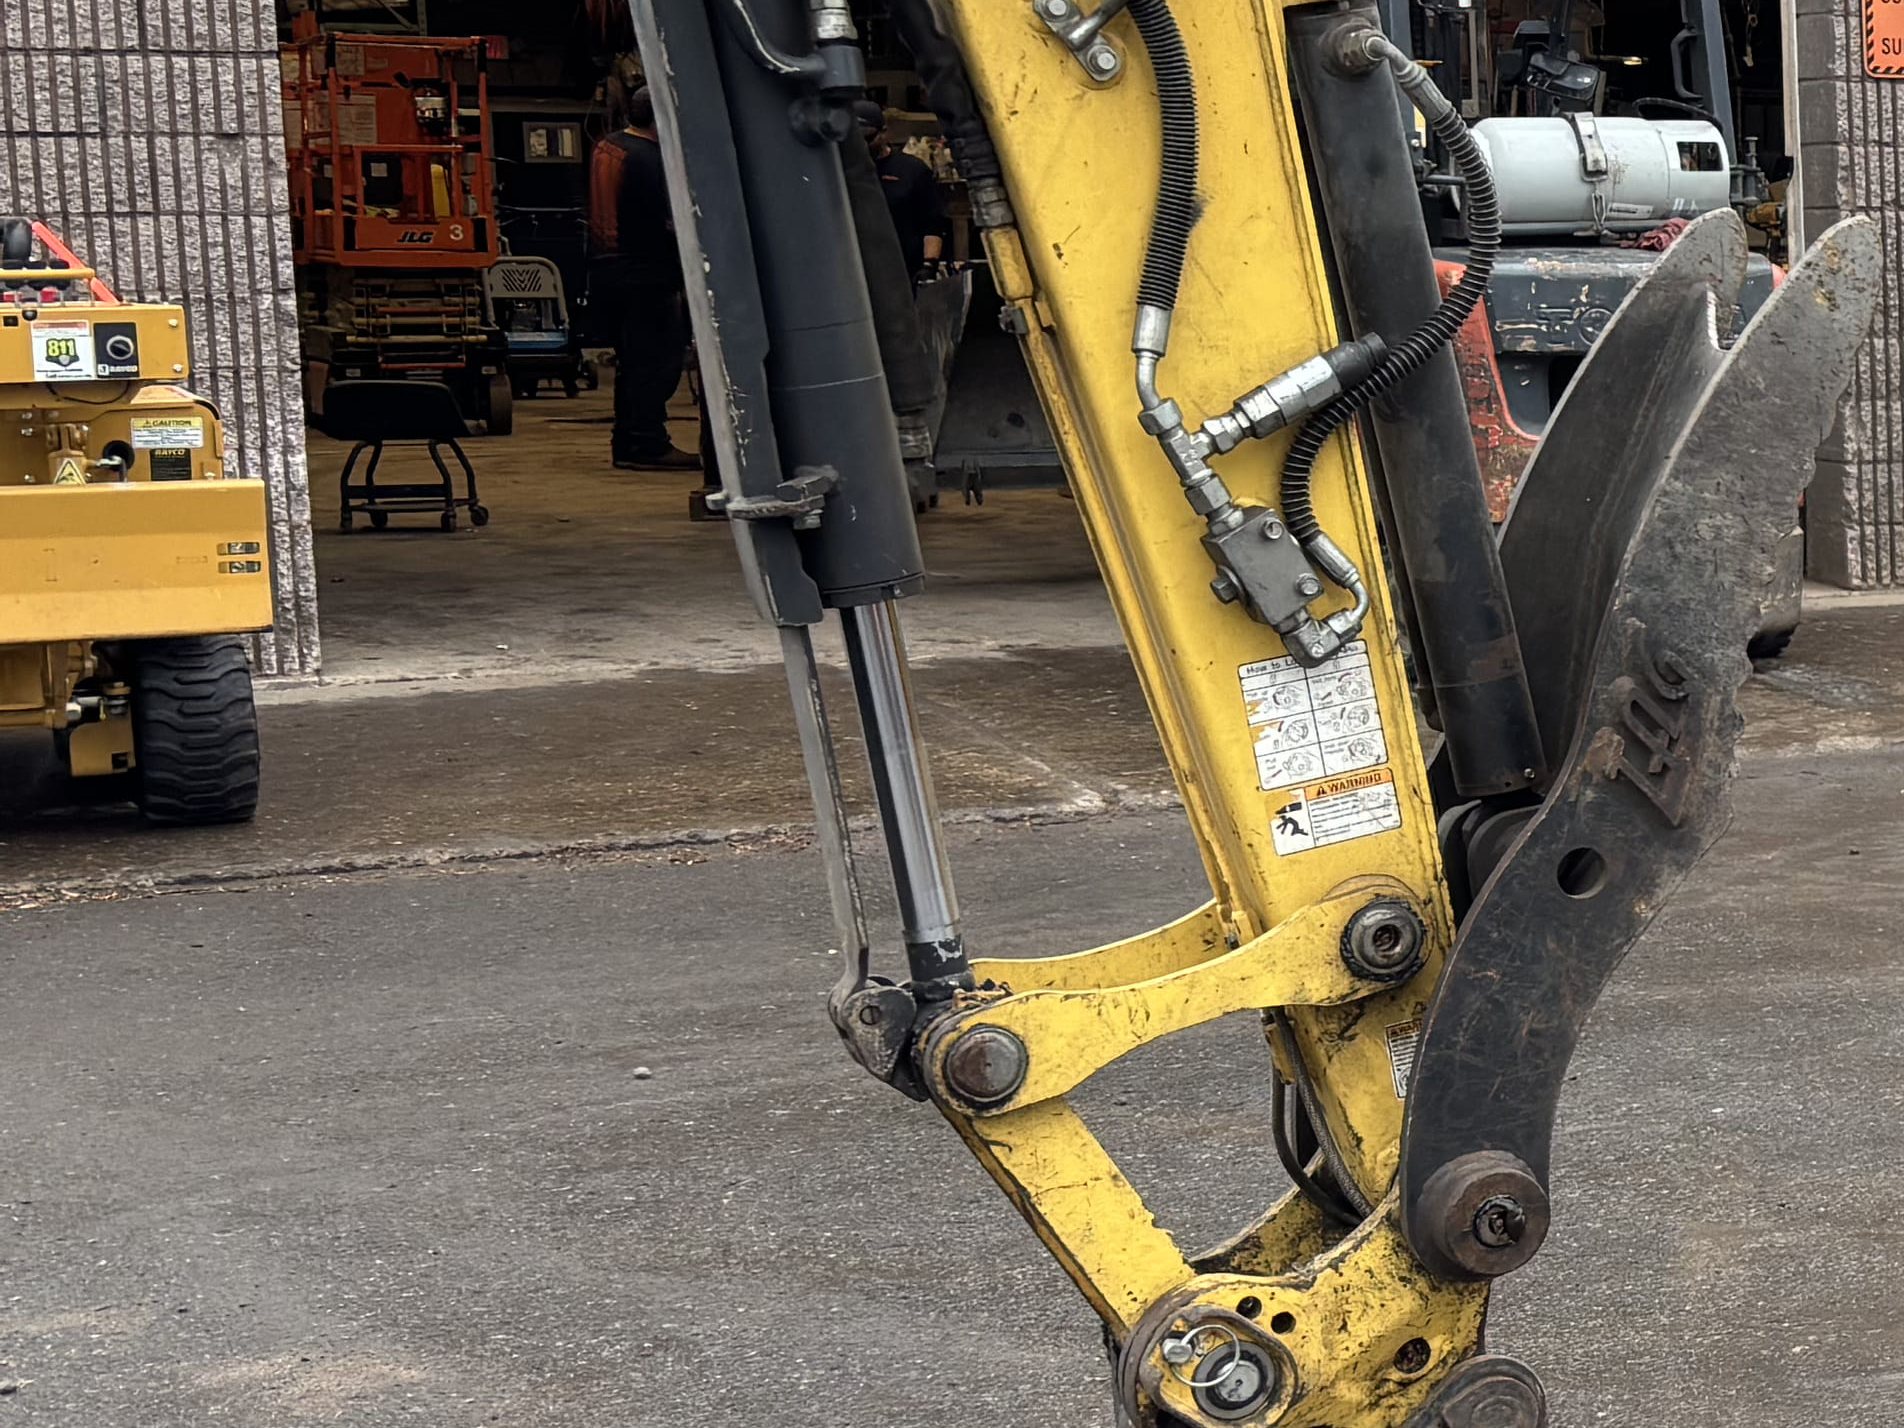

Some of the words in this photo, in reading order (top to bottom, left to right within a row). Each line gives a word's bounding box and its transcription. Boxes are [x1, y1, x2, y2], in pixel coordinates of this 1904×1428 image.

[397, 230, 436, 245] JLG
[449, 224, 464, 241] 3
[47, 339, 75, 356] 811
[152, 419, 192, 427] CAUTION
[1328, 772, 1382, 793] WARNING
